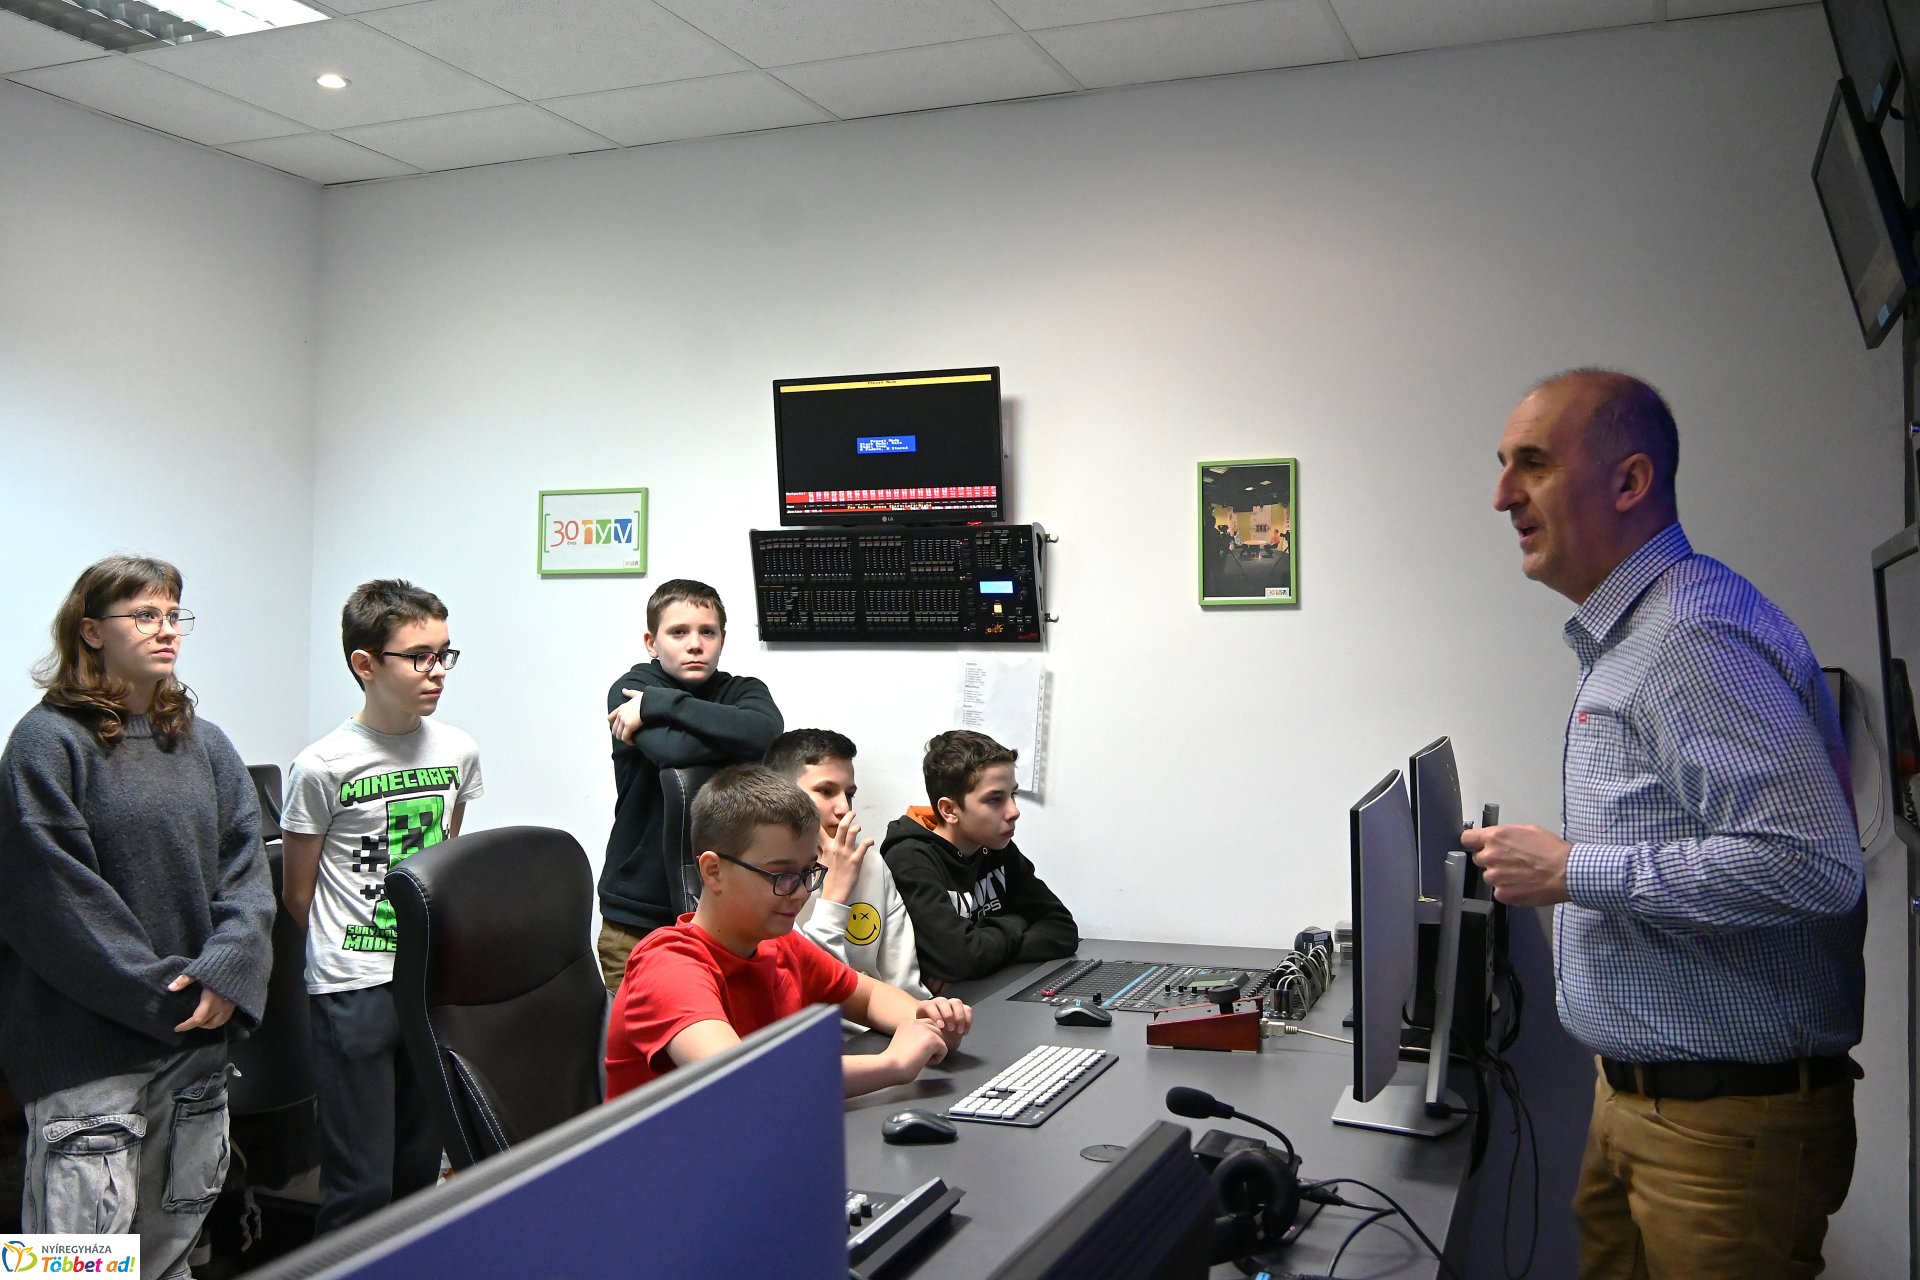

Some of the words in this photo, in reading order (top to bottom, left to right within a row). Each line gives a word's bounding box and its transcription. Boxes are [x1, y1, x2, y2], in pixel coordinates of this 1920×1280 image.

[550, 520, 580, 548] 30
[340, 766, 460, 806] MINECRAFT
[343, 934, 397, 951] MODE
